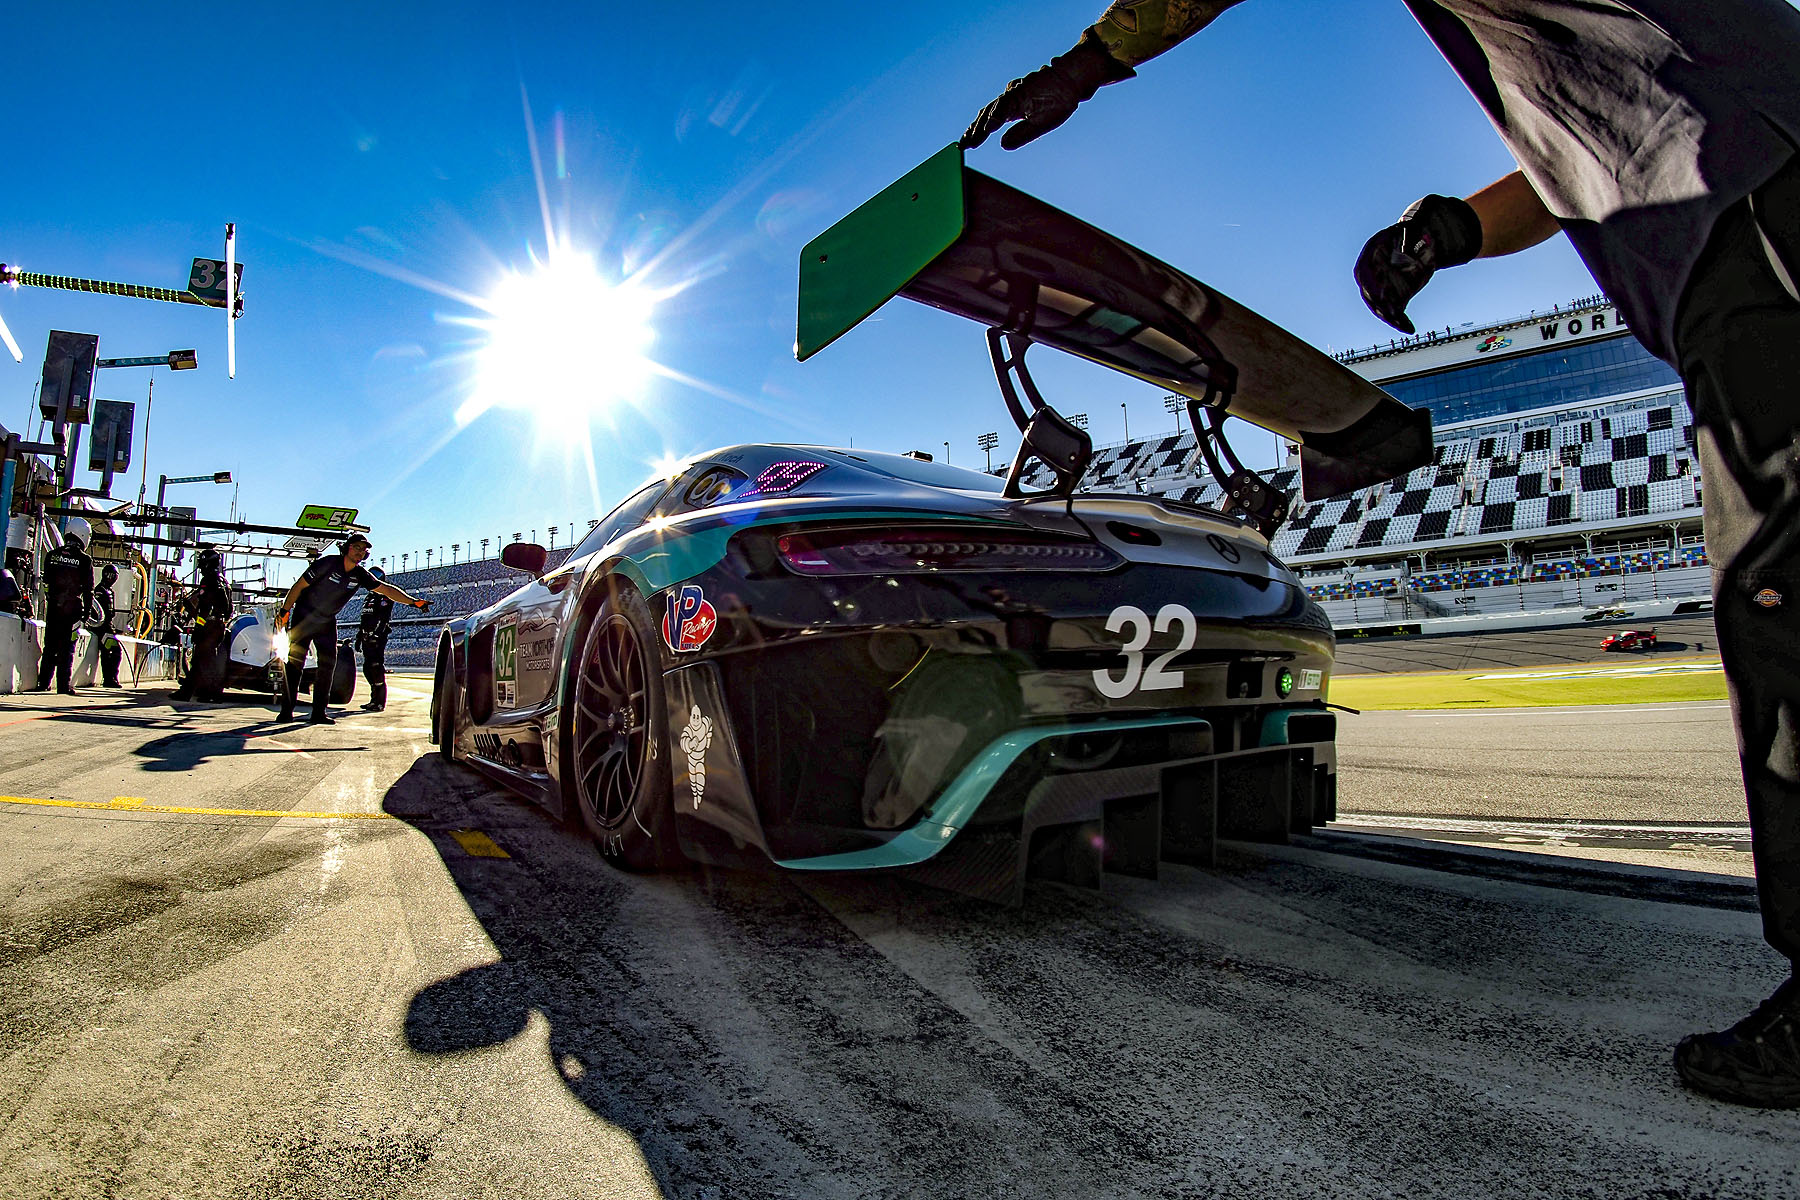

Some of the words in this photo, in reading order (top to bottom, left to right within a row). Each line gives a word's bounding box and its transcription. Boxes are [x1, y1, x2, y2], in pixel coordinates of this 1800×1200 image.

[190, 260, 242, 291] 32
[666, 586, 704, 650] VP
[681, 616, 716, 642] Racing
[498, 630, 513, 678] 32
[1092, 604, 1197, 699] 32
